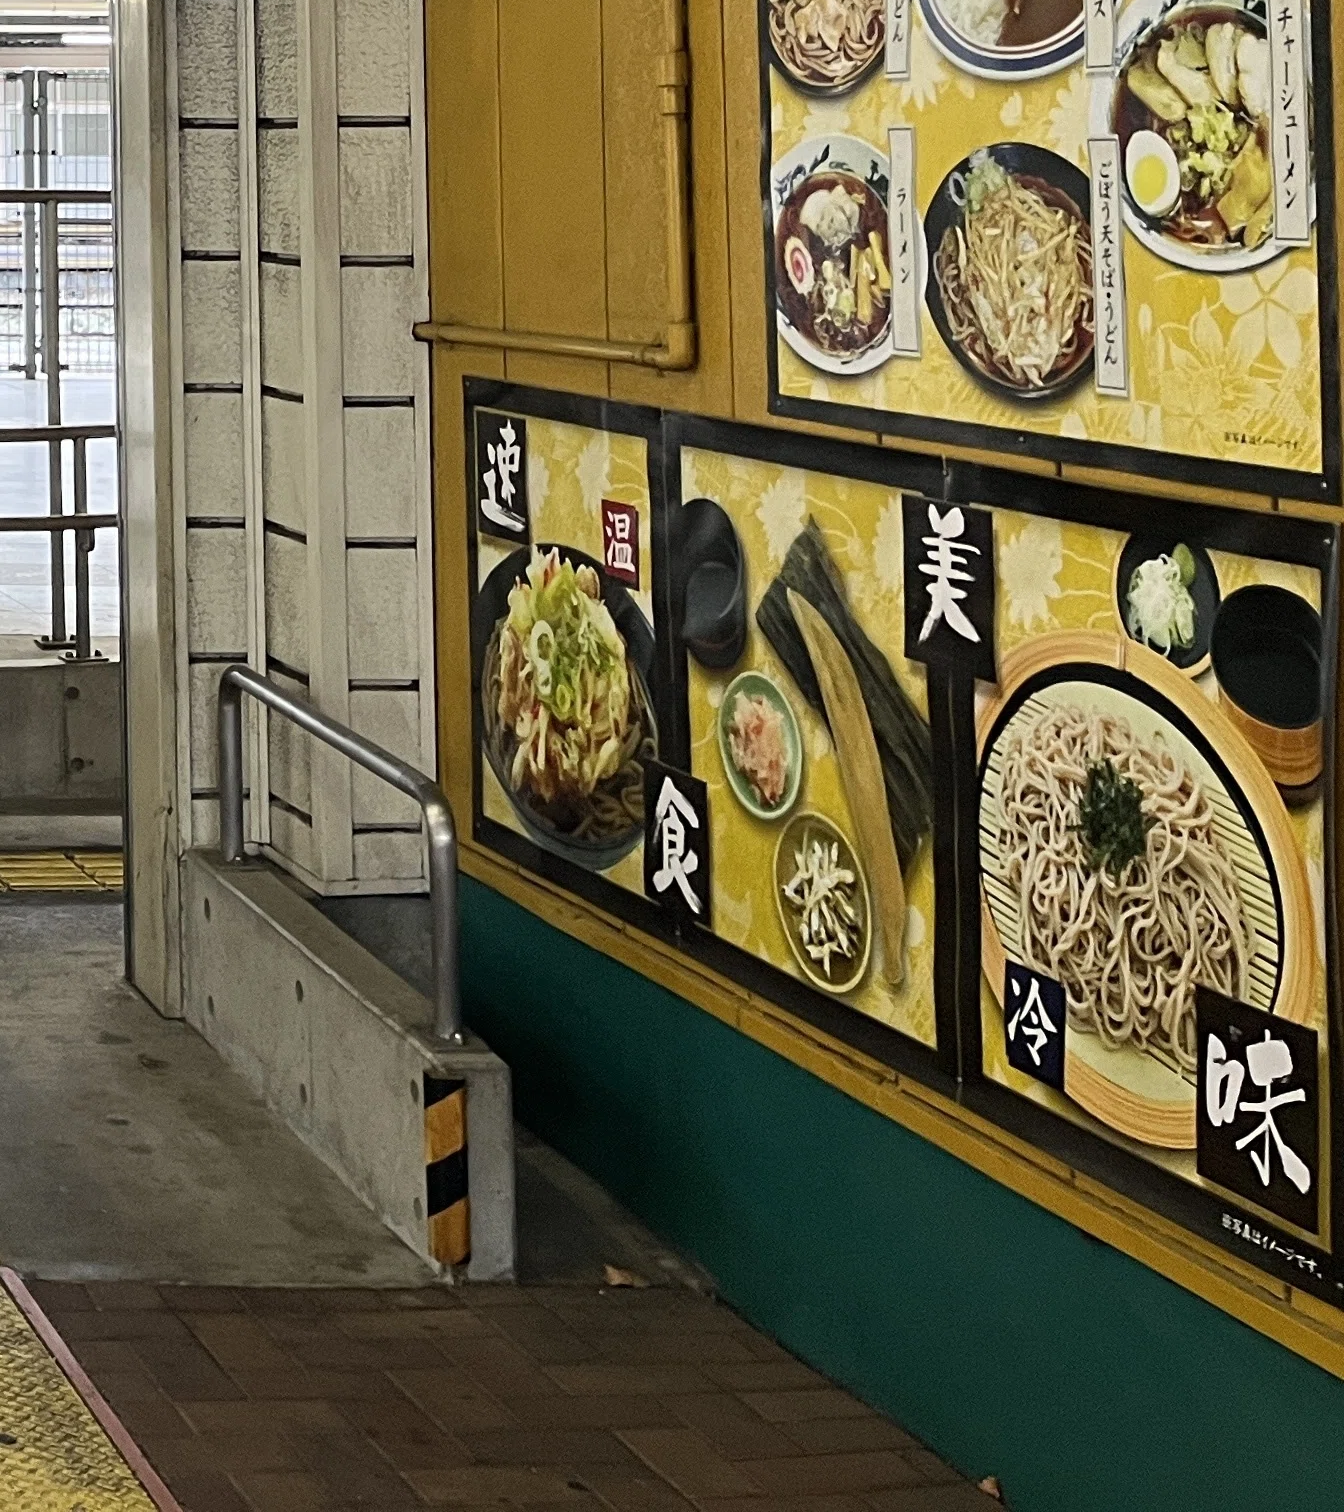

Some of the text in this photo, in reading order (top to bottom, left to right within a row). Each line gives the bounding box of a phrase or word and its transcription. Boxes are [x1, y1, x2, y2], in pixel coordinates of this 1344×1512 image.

[1277, 7, 1298, 208] チャーシューメン
[896, 188, 911, 285] ラーメン
[1098, 161, 1118, 366] ごぼう天そば・うどん
[603, 510, 636, 574] 温
[917, 502, 983, 644] 美
[653, 776, 702, 915] 食
[1006, 976, 1058, 1067] 冷
[1205, 1028, 1311, 1195] 味
